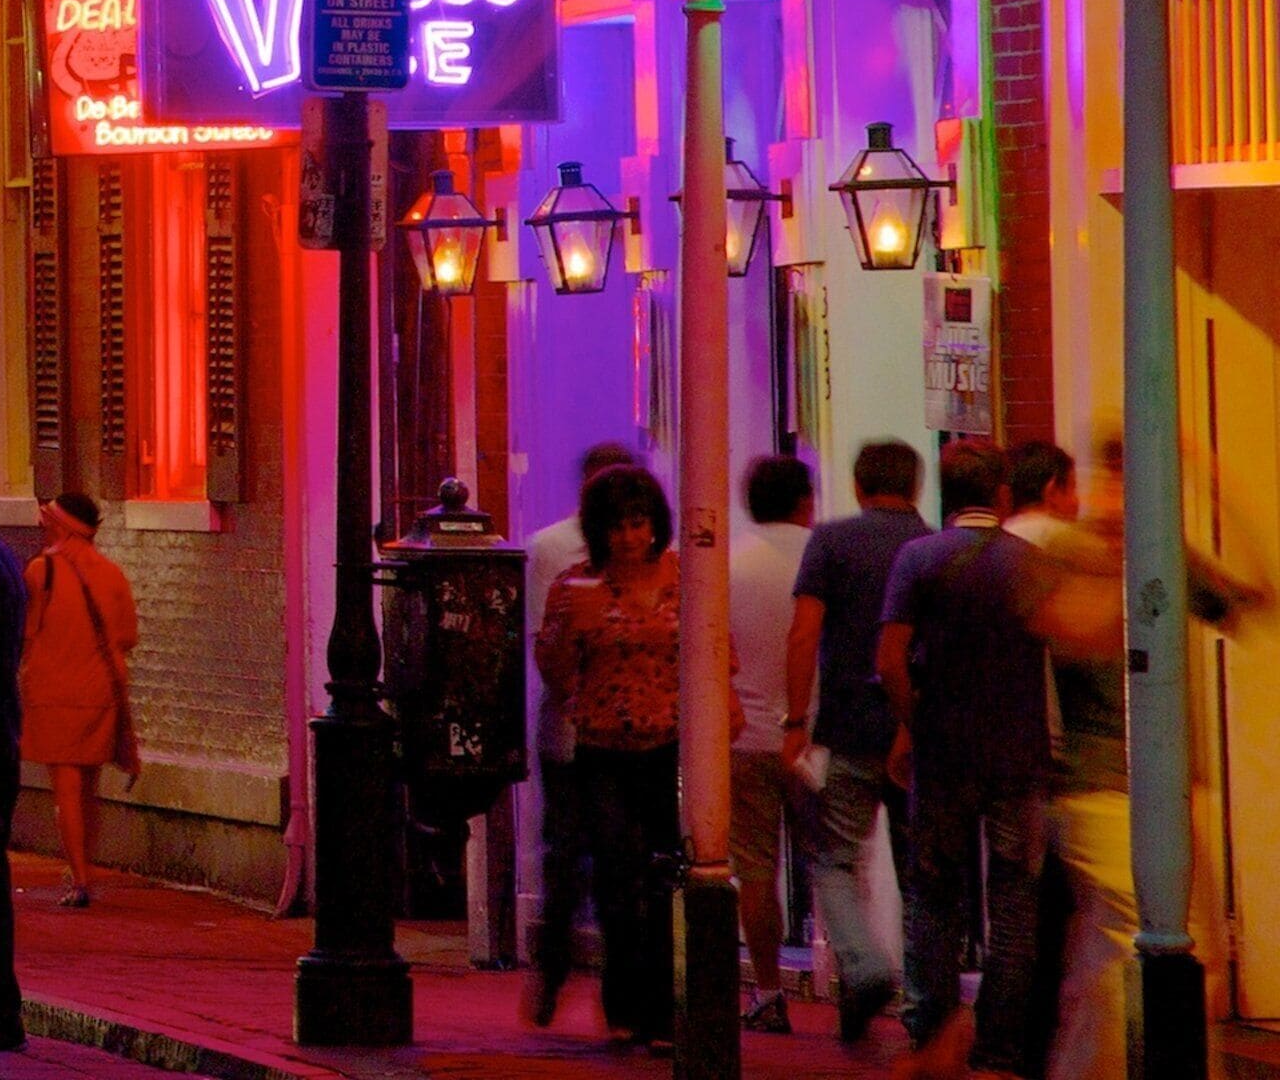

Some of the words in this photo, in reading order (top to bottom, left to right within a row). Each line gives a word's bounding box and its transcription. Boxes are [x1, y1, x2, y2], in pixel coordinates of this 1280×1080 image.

[331, 17, 349, 28] ALL
[341, 30, 365, 41] MAY
[331, 42, 345, 53] IN
[347, 42, 391, 54] PLASTIC
[328, 54, 394, 66] CONTAINERS
[925, 359, 988, 392] MUSIC
